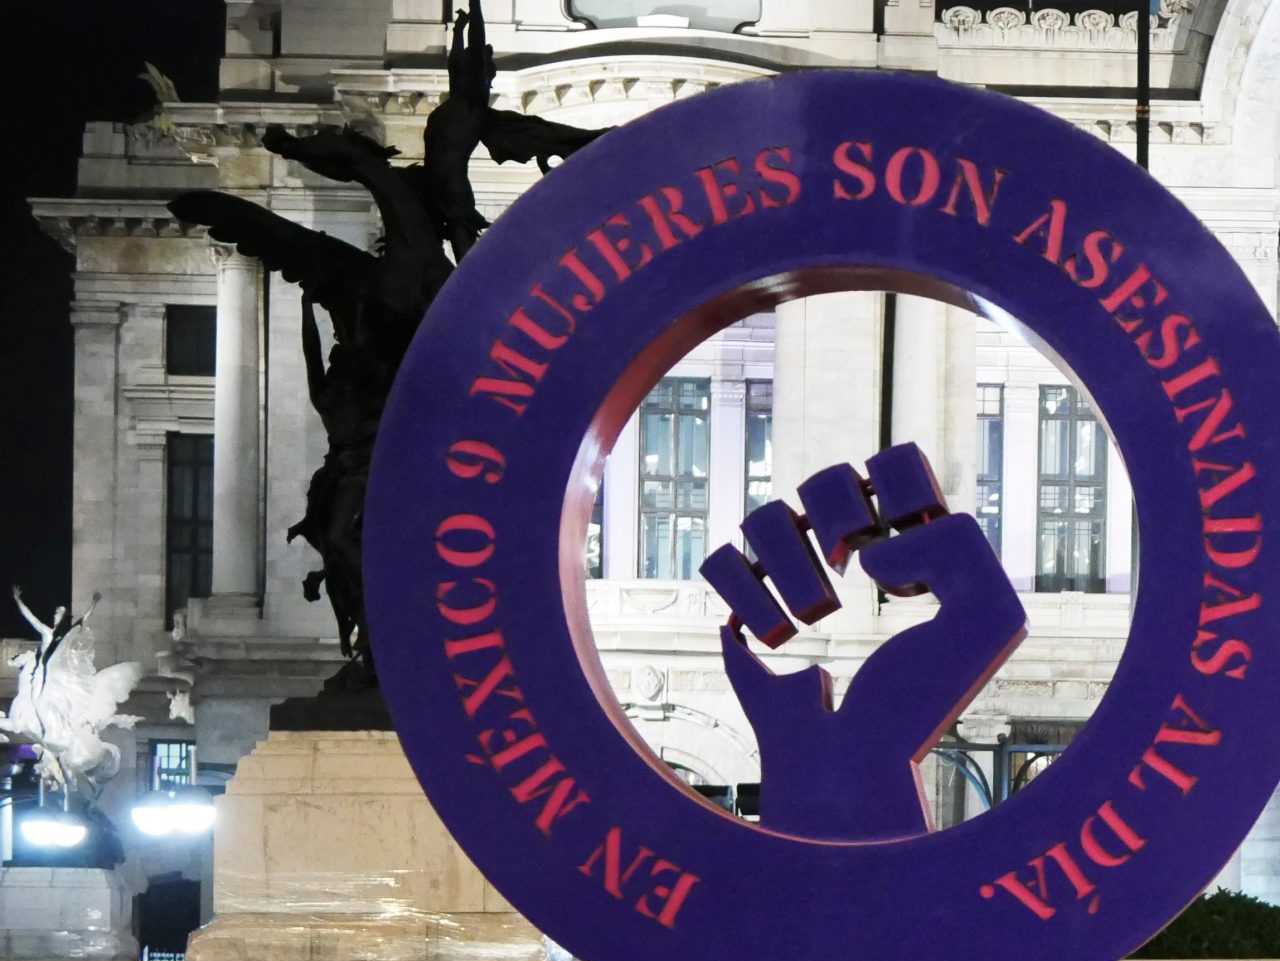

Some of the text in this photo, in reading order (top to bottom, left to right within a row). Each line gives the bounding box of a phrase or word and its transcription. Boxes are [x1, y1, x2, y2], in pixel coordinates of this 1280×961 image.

[434, 140, 1264, 928] EN MÉXICO 9 MUJERES SON ASESINADAS AL DÍA.
